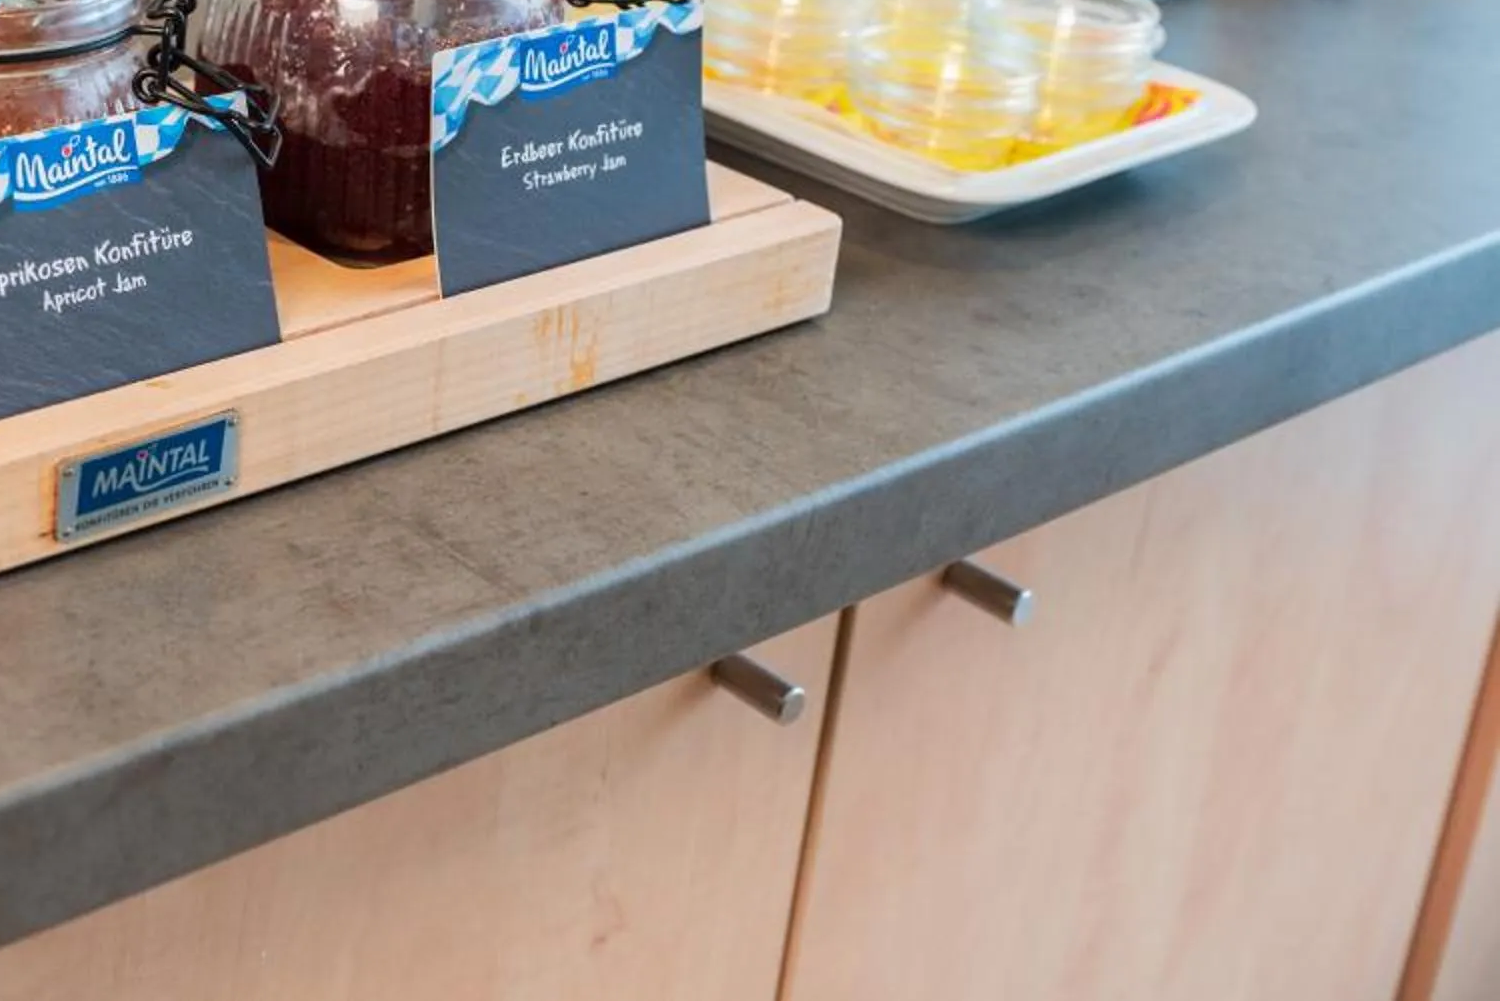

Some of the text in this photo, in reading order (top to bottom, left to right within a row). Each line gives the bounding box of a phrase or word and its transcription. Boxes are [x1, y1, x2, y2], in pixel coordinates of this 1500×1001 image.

[525, 28, 612, 81] Maintal
[15, 127, 132, 190] Maintal
[501, 119, 644, 169] Erdbeer Konfitüre
[523, 153, 627, 190] Strawberry Jam
[94, 225, 194, 266] Konfitüre
[43, 272, 147, 313] Apricot Jam
[92, 439, 210, 498] MAINTAL
